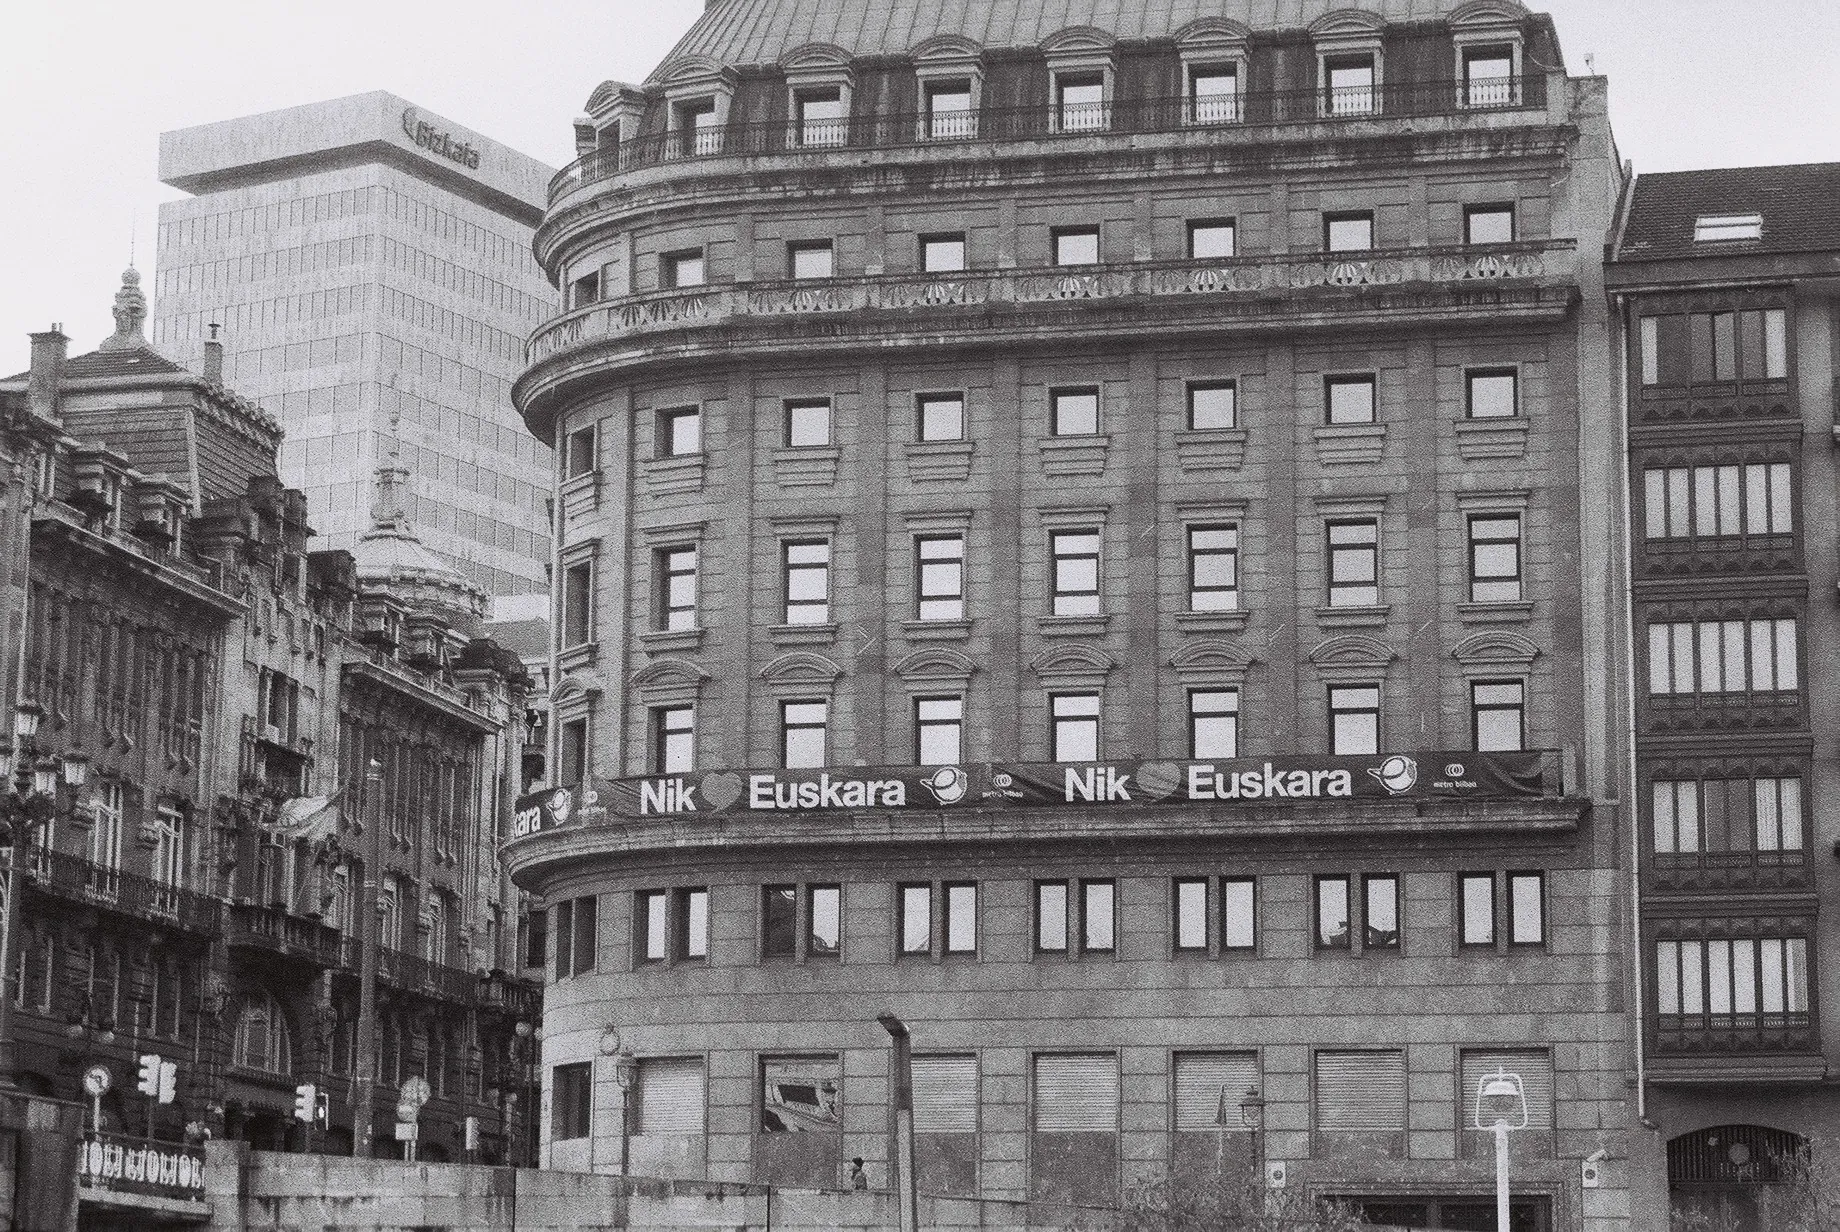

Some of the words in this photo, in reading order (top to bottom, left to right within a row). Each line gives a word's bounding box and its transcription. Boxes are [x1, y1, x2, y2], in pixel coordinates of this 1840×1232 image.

[640, 777, 697, 815] Nik
[750, 773, 906, 809] Euskara
[1065, 766, 1131, 802] Nik
[1188, 762, 1353, 799] Euskara
